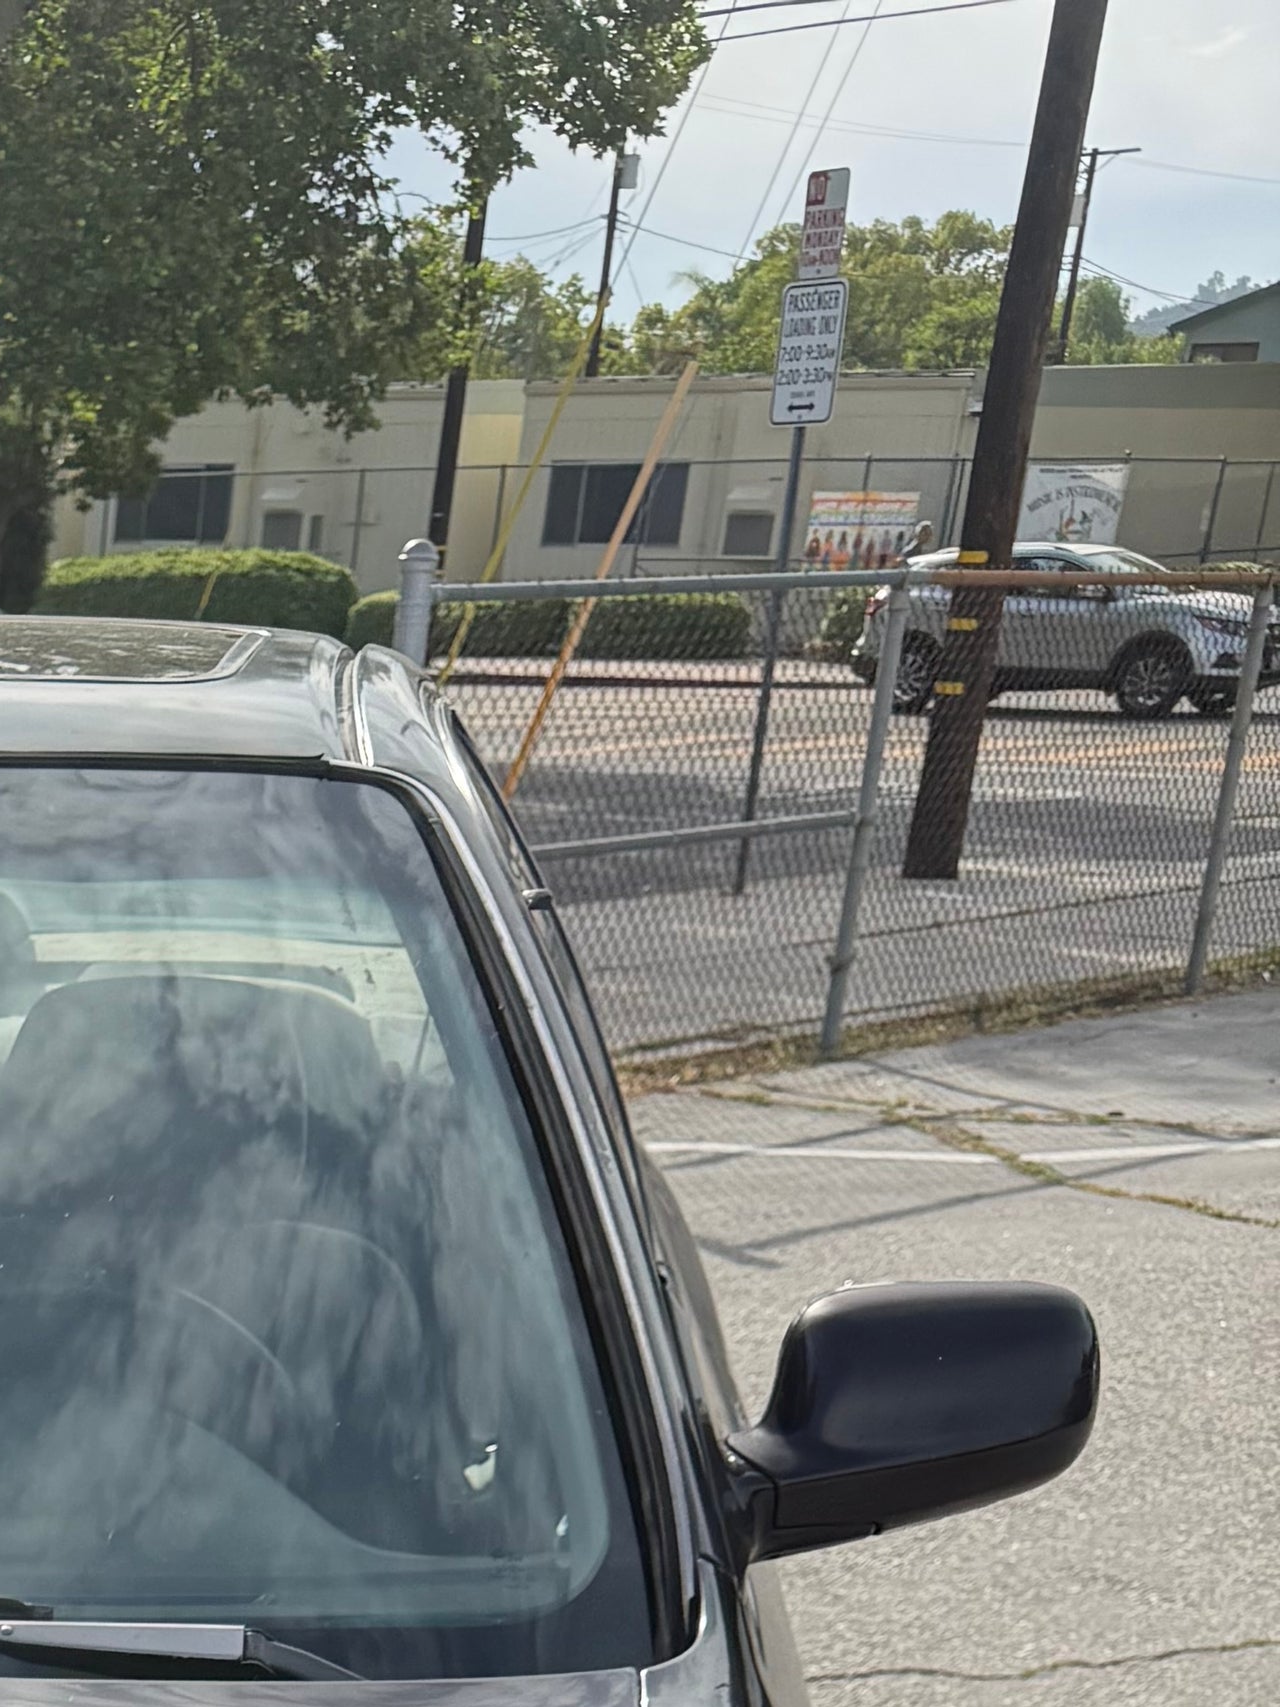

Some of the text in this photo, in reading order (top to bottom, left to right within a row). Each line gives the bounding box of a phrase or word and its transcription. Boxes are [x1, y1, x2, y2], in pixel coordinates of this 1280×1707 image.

[805, 208, 844, 229] PARKING
[804, 230, 839, 249] MONDAY
[787, 289, 840, 313] PASSENGER
[783, 315, 838, 337] LOADING ONLY
